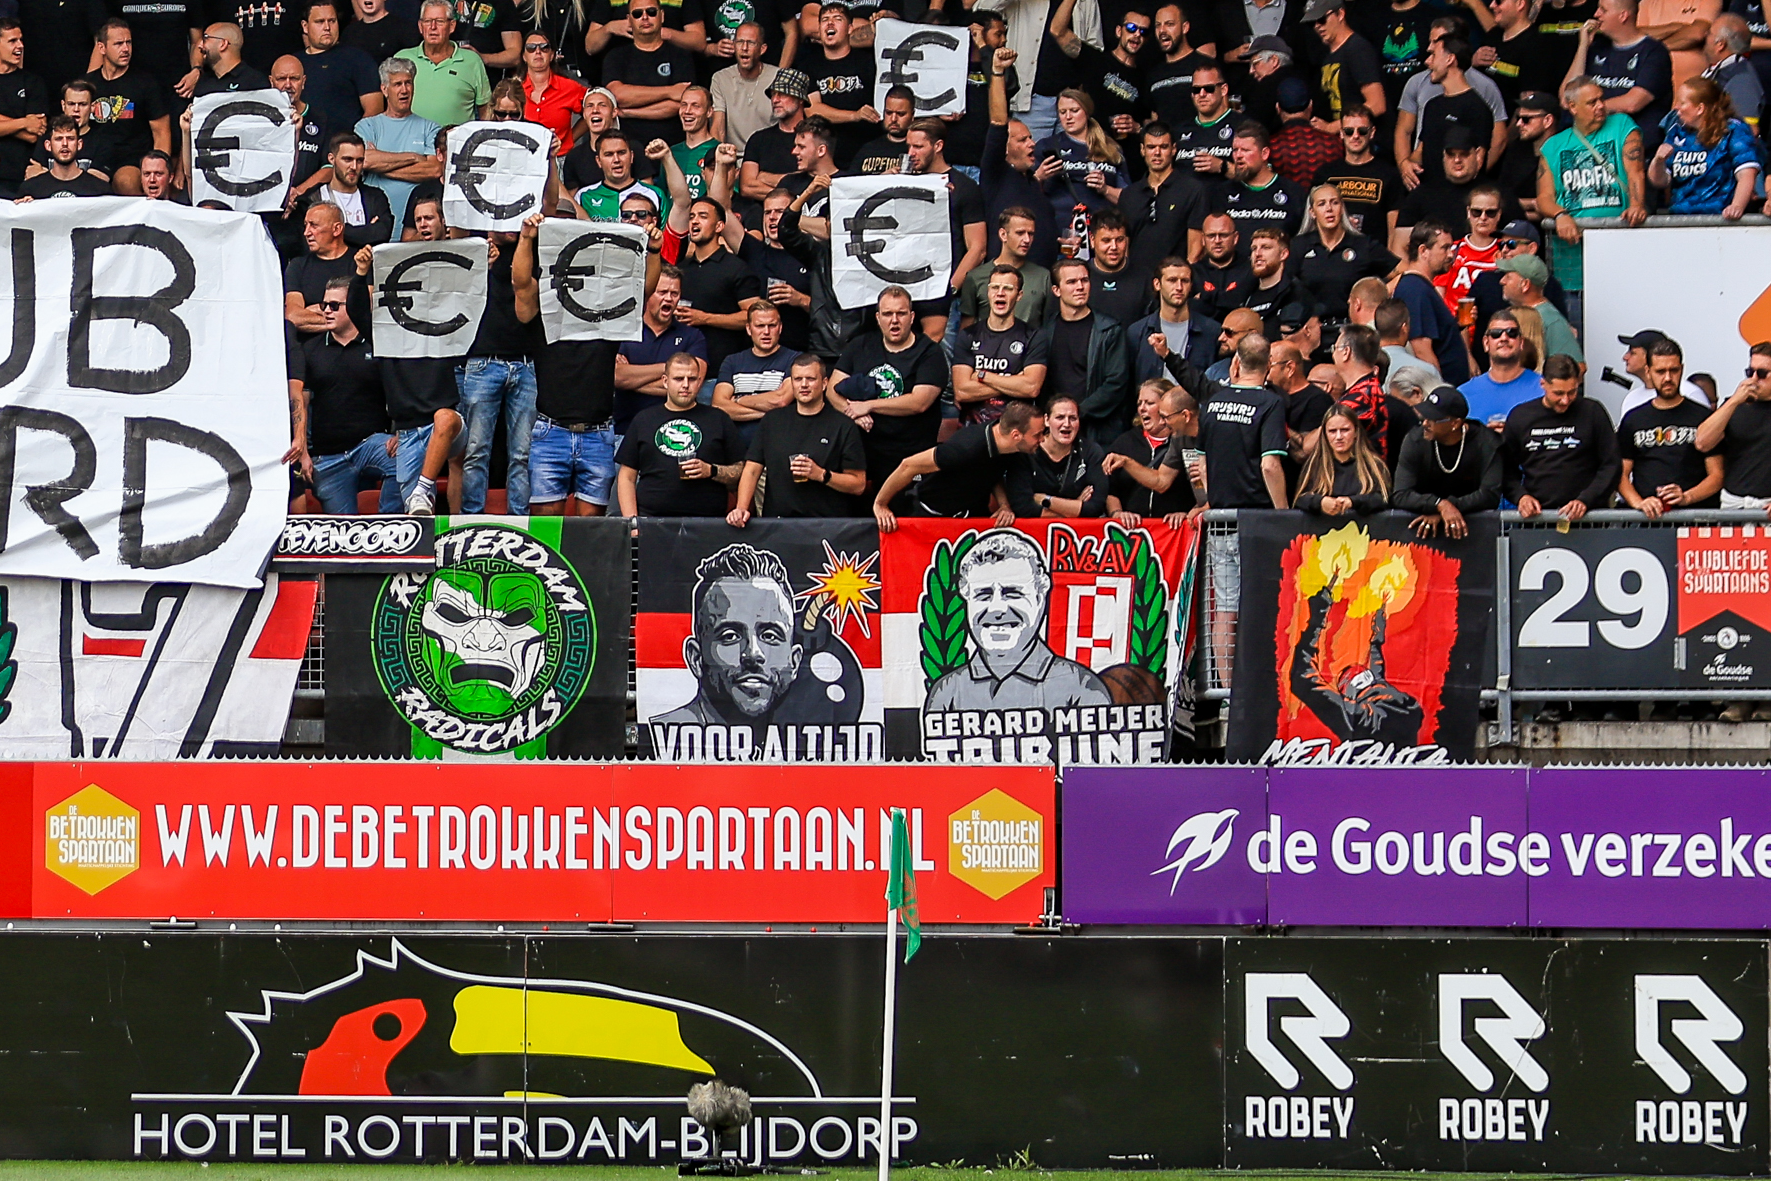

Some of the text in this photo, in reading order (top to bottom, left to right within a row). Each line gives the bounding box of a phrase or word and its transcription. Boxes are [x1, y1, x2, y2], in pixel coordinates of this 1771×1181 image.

[1672, 161, 1708, 178] Parcs
[1673, 150, 1708, 164] Euro
[974, 354, 1009, 371] Euro
[278, 521, 419, 555] FEYENOORD
[1684, 549, 1769, 571] CLUBLIEFDE
[1518, 546, 1670, 650] 29
[394, 685, 562, 752] RADICALS
[925, 704, 1165, 737] GERARD MEIJER
[654, 724, 754, 761] VOOR
[68, 805, 78, 816] DE
[971, 809, 981, 820] DE
[49, 815, 136, 839] BETROKKEN
[952, 820, 1039, 844] BETROKKEN
[58, 839, 136, 864] SPARTAAN
[961, 844, 1039, 869] SPARTAAN
[1246, 815, 1318, 876] de
[1331, 815, 1551, 877] Goudse
[1245, 1097, 1354, 1138] ROBEY
[1439, 1099, 1550, 1140] ROBEY
[1636, 1101, 1748, 1143] ROBEY
[134, 1113, 919, 1166] HOTEL ROTTERDAM-BIJDORP
